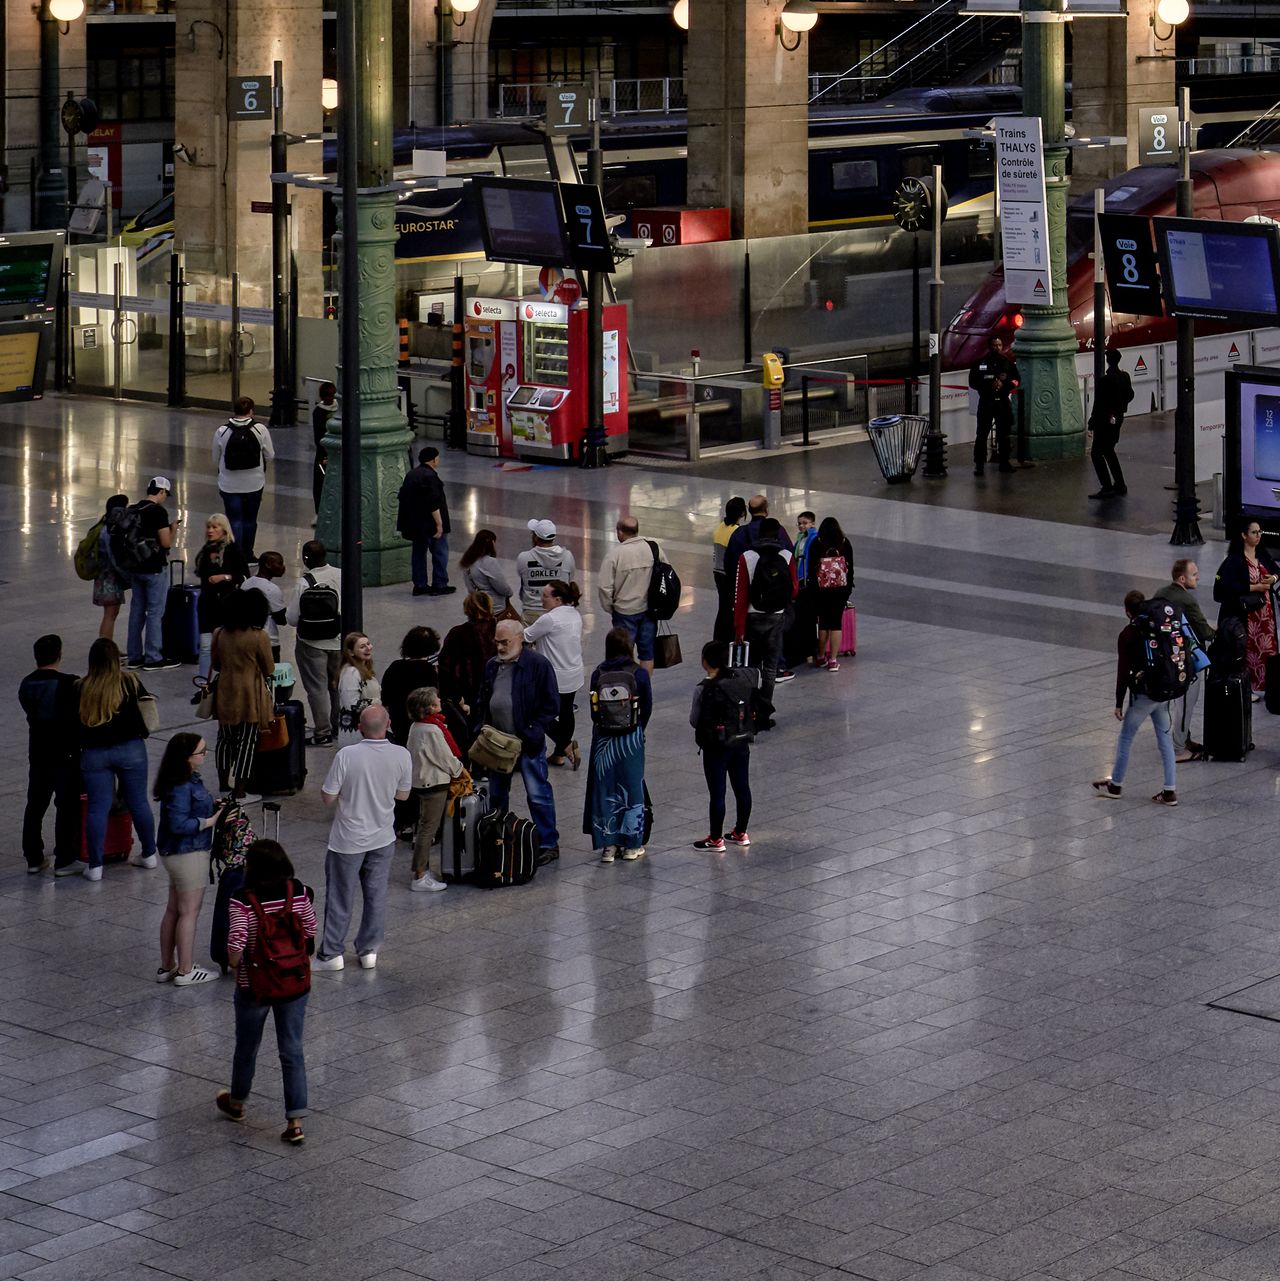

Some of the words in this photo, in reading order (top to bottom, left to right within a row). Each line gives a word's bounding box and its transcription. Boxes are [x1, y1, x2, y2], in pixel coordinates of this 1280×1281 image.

[245, 91, 257, 110] 6
[562, 103, 574, 123] 7
[999, 128, 1026, 138] Trains
[1154, 126, 1166, 150] 8
[1000, 143, 1036, 152] THALYS
[1001, 158, 1034, 166] Contrôle
[1014, 170, 1037, 179] sûreté
[394, 220, 454, 233] EUROSTAR
[580, 218, 592, 243] 7
[1119, 240, 1134, 249] Voie
[1122, 254, 1138, 282] 8
[483, 306, 501, 314] selecta
[534, 309, 557, 317] selecta
[1200, 424, 1224, 432] Temporary
